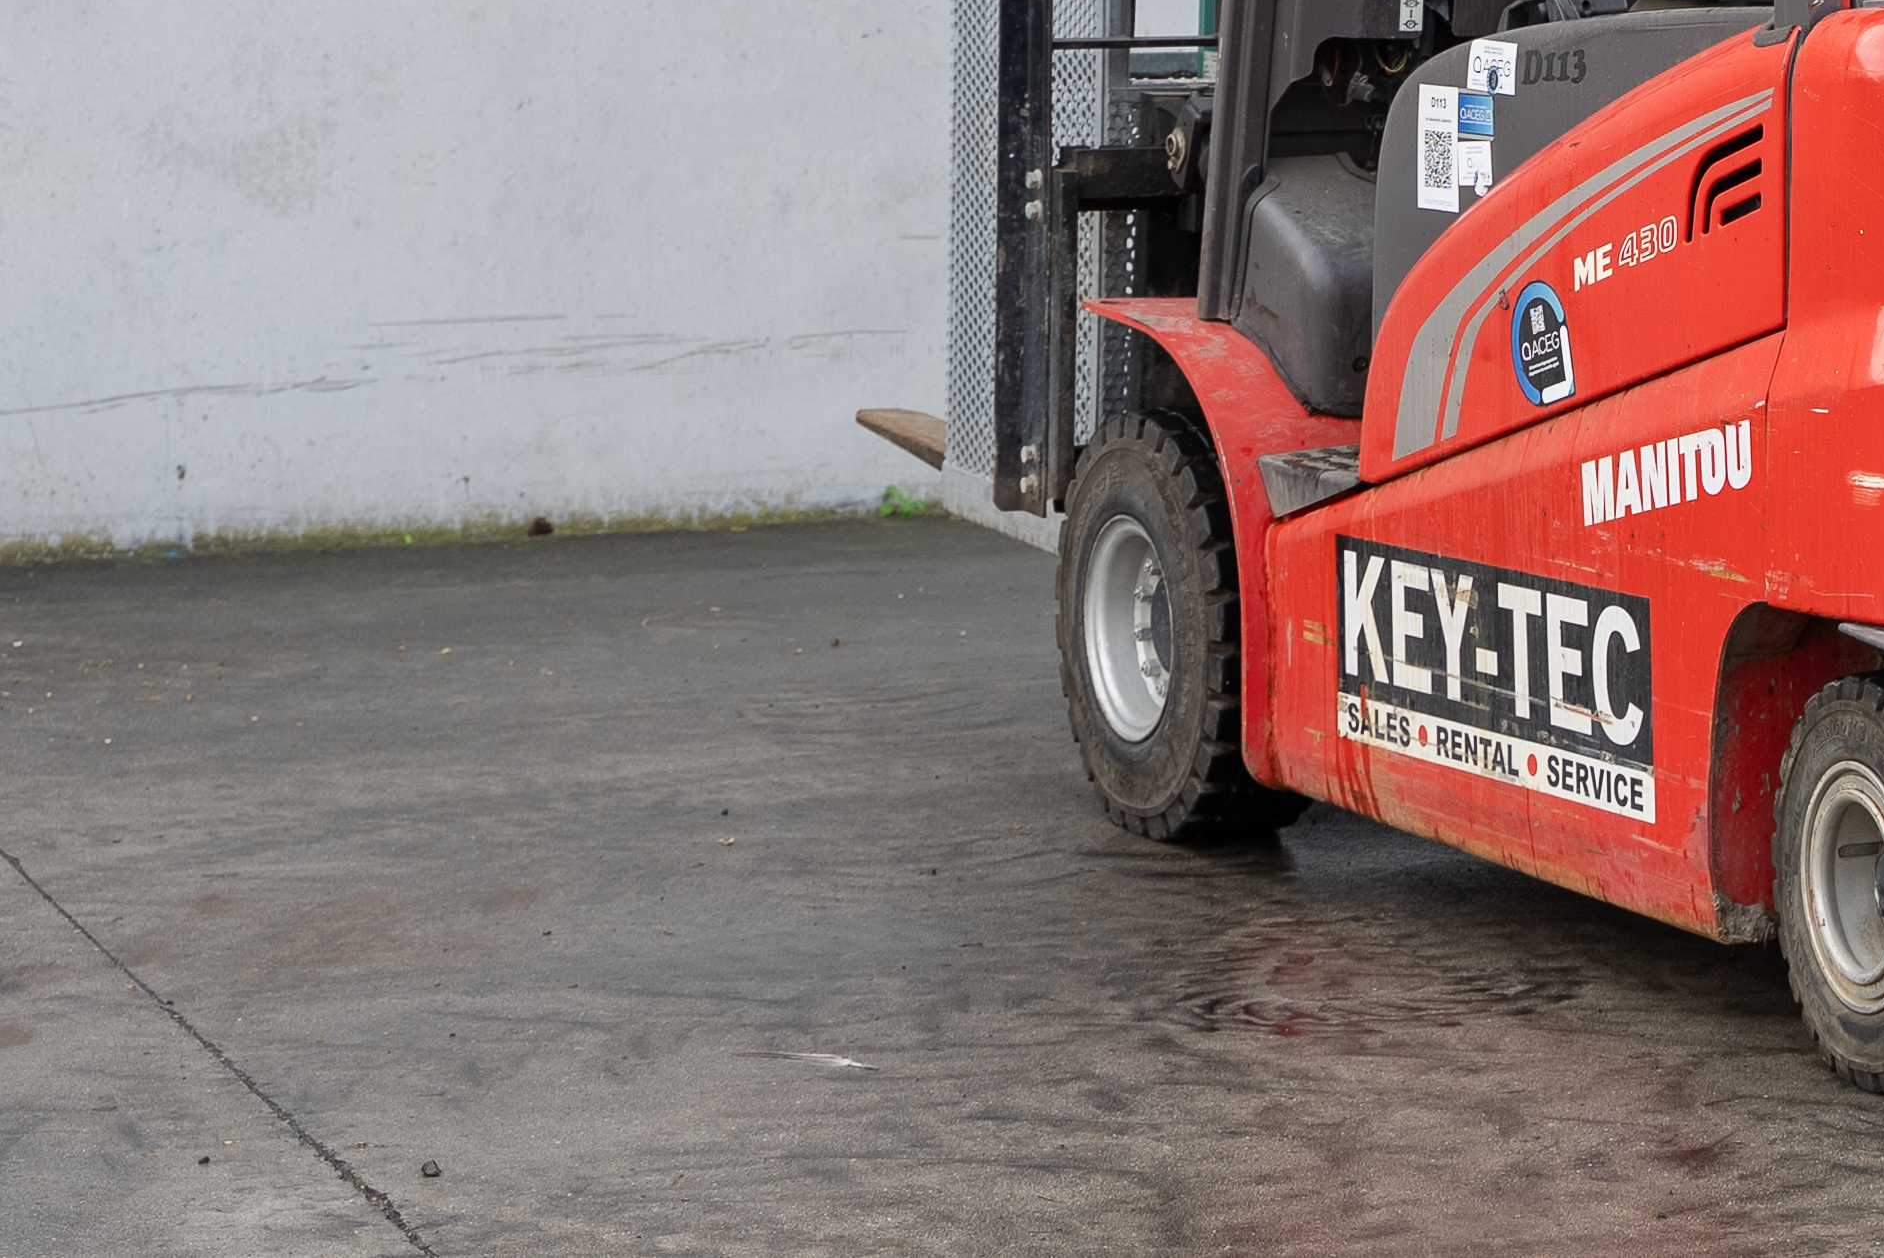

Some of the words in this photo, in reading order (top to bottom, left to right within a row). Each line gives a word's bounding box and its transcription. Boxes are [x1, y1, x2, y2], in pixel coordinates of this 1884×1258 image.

[1430, 96, 1447, 109] D113
[1521, 48, 1588, 86] D113
[1573, 242, 1613, 292] ME
[1618, 215, 1678, 267] 430
[1581, 418, 1752, 527] MANITOU
[1343, 549, 1645, 746] KEY-TEC
[1348, 702, 1411, 748] SALES
[1436, 725, 1519, 778] RENTAL
[1546, 754, 1645, 812] SERVICE
